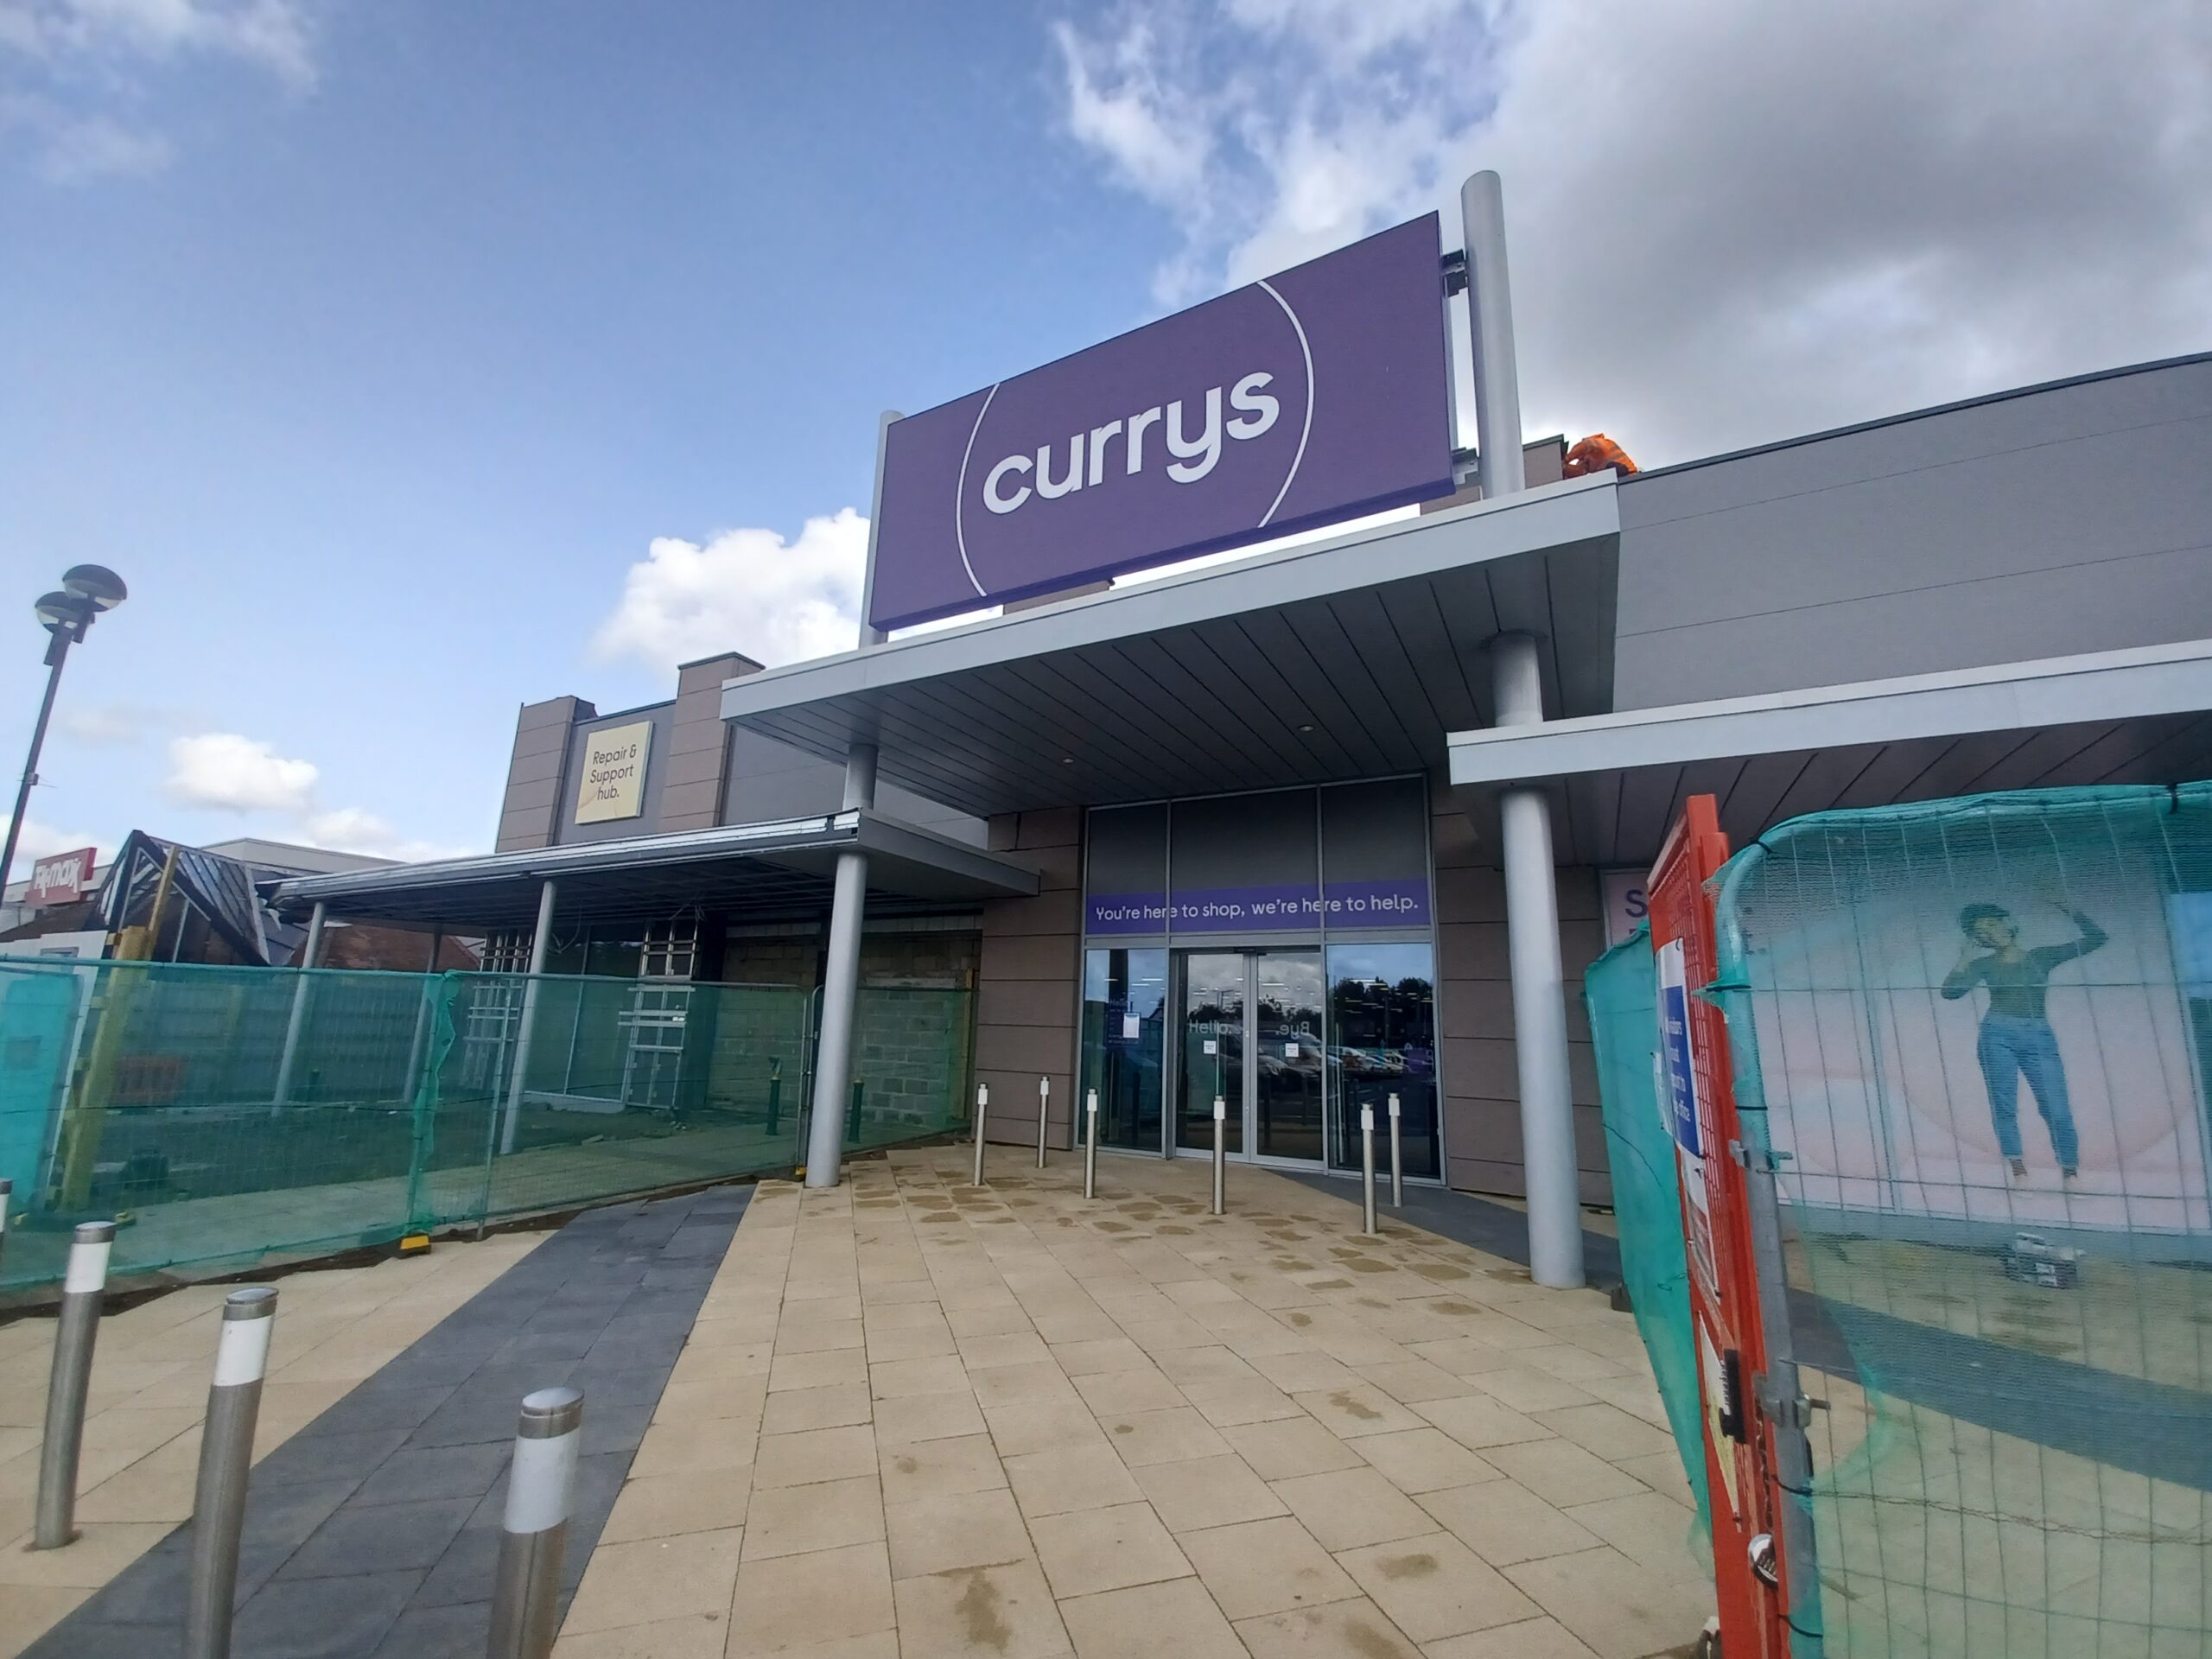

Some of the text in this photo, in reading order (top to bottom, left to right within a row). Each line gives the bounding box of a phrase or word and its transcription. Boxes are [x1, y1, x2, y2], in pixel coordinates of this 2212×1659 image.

[982, 372, 1281, 514] currys
[593, 744, 637, 766] Repair &
[590, 764, 634, 785] Support
[597, 785, 620, 801] hub.
[1096, 893, 1419, 921] You're here to shop, we're here to help.
[1189, 1019, 1232, 1035] Hello.
